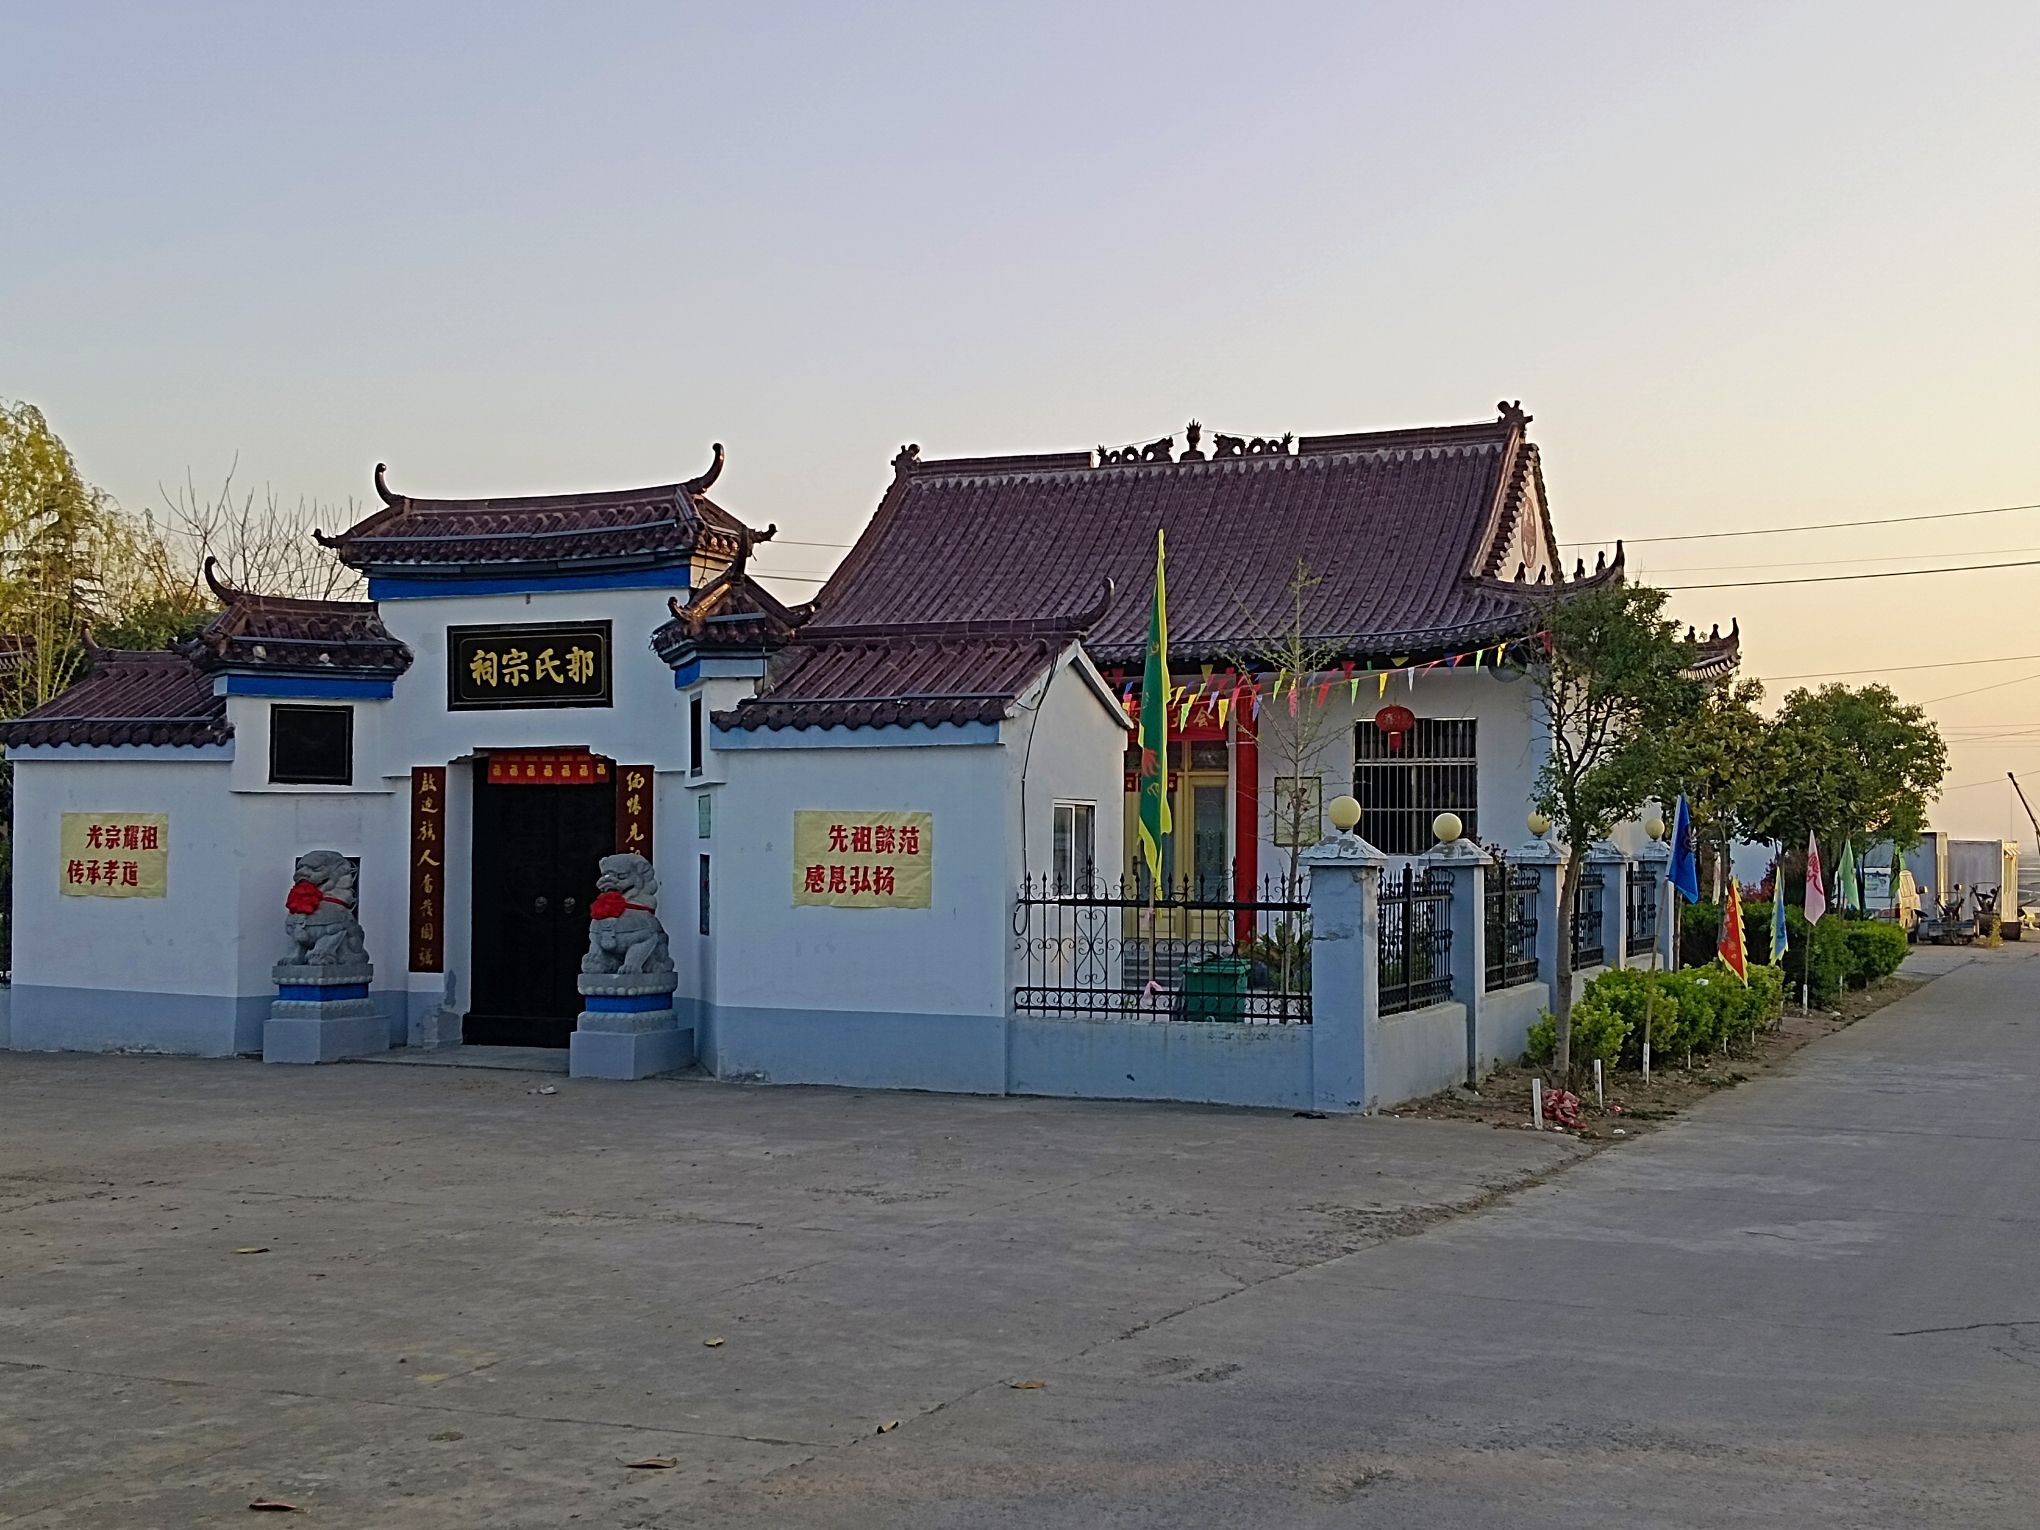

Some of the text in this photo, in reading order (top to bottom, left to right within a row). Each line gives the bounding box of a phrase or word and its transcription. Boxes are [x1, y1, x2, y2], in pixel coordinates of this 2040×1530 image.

[469, 646, 594, 687] 郭氏宗祠
[85, 824, 158, 850] 光宗耀祖
[828, 824, 920, 855] 先祖懿范
[67, 859, 138, 887] 传承孝道
